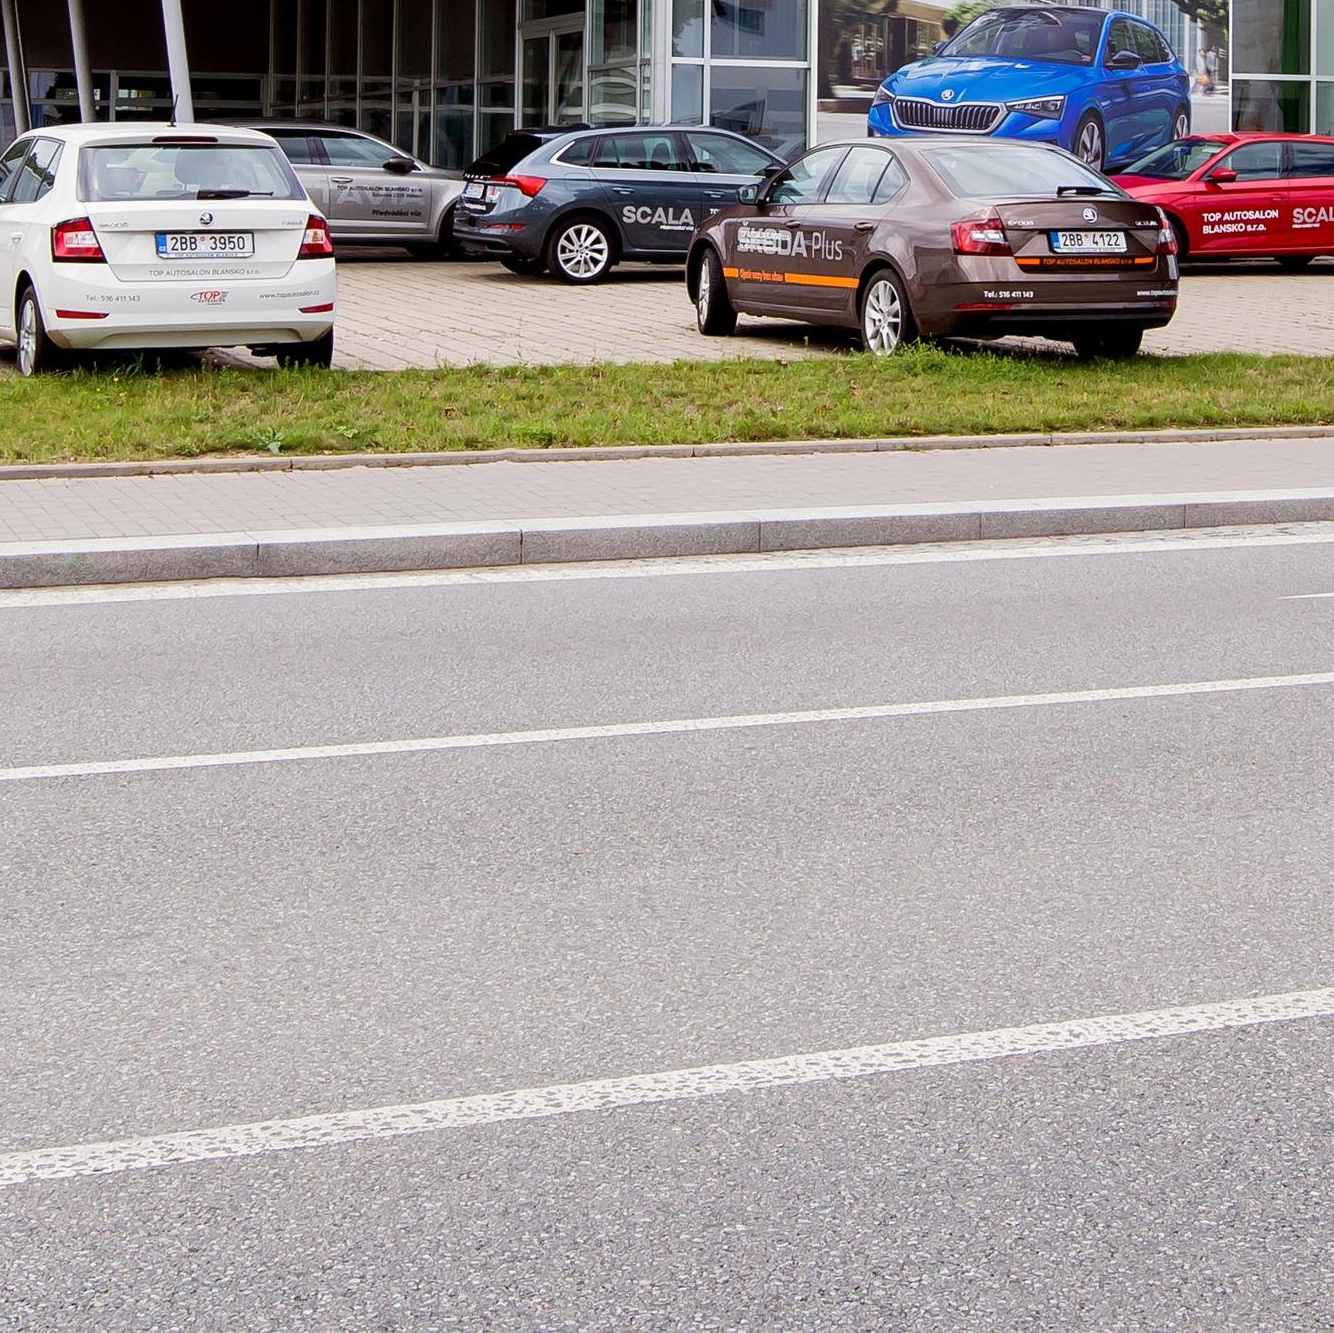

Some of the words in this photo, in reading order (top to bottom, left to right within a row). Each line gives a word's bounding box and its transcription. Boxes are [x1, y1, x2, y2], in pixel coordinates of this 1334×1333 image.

[622, 205, 695, 226] SCALA
[1202, 212, 1222, 223] TOP
[1223, 209, 1279, 222] AUTOSALON
[1202, 222, 1246, 235] BLANSKO
[1246, 223, 1267, 232] s.r.o.
[170, 236, 198, 251] 2BB
[209, 235, 246, 251] 3950
[736, 220, 808, 258] ŠKODA
[811, 230, 843, 261] Plus
[1061, 233, 1083, 247] 2BB
[1092, 233, 1121, 247] 4122
[148, 269, 165, 277] TOP
[212, 268, 246, 276] BLANSKO
[198, 290, 221, 300] TOP
[999, 290, 1010, 298] 516
[1011, 290, 1022, 298] 411
[1022, 290, 1034, 298] 143
